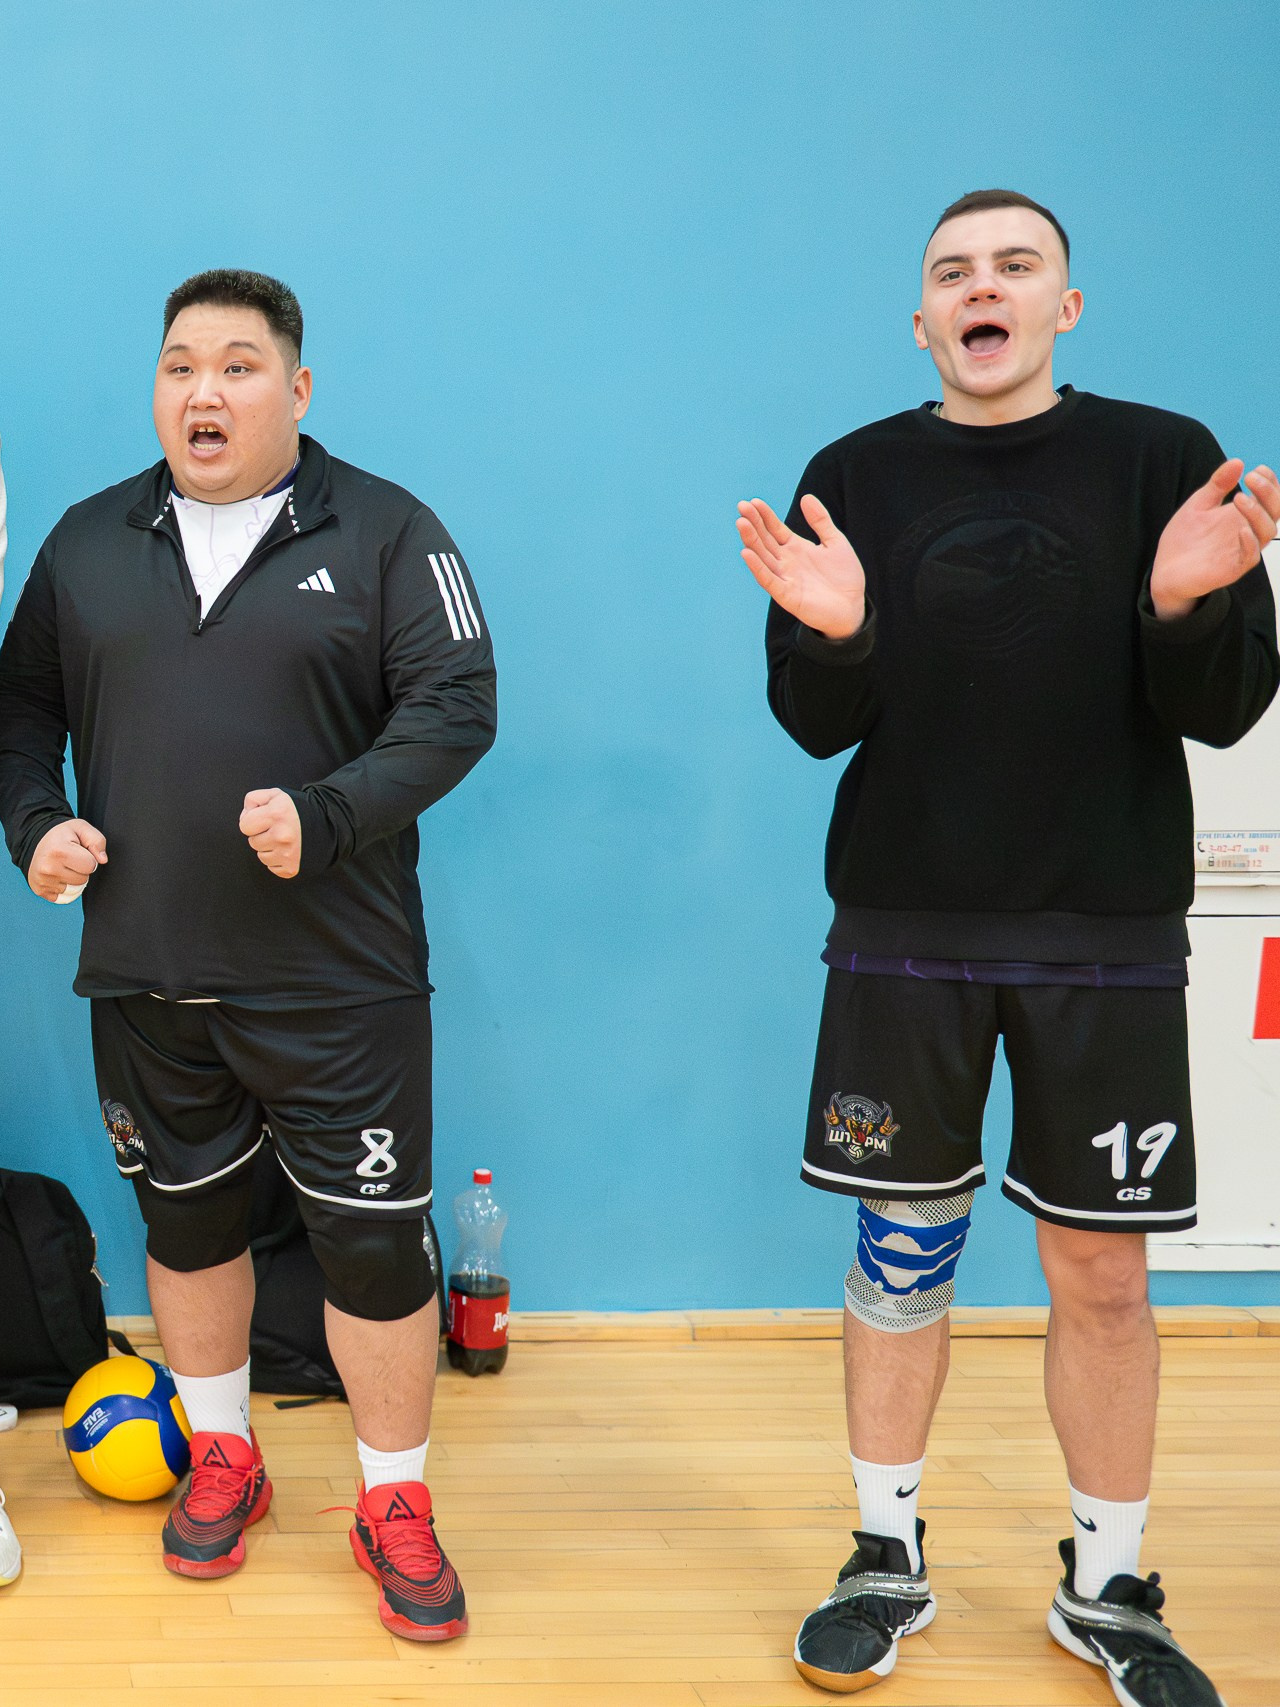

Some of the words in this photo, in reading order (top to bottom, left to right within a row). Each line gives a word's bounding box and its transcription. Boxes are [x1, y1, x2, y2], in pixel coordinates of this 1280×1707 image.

[828, 1129, 887, 1152] ШТРМ
[1091, 1121, 1178, 1181] 19
[356, 1128, 398, 1178] 8
[360, 1183, 391, 1196] GS
[1116, 1186, 1153, 1201] GS
